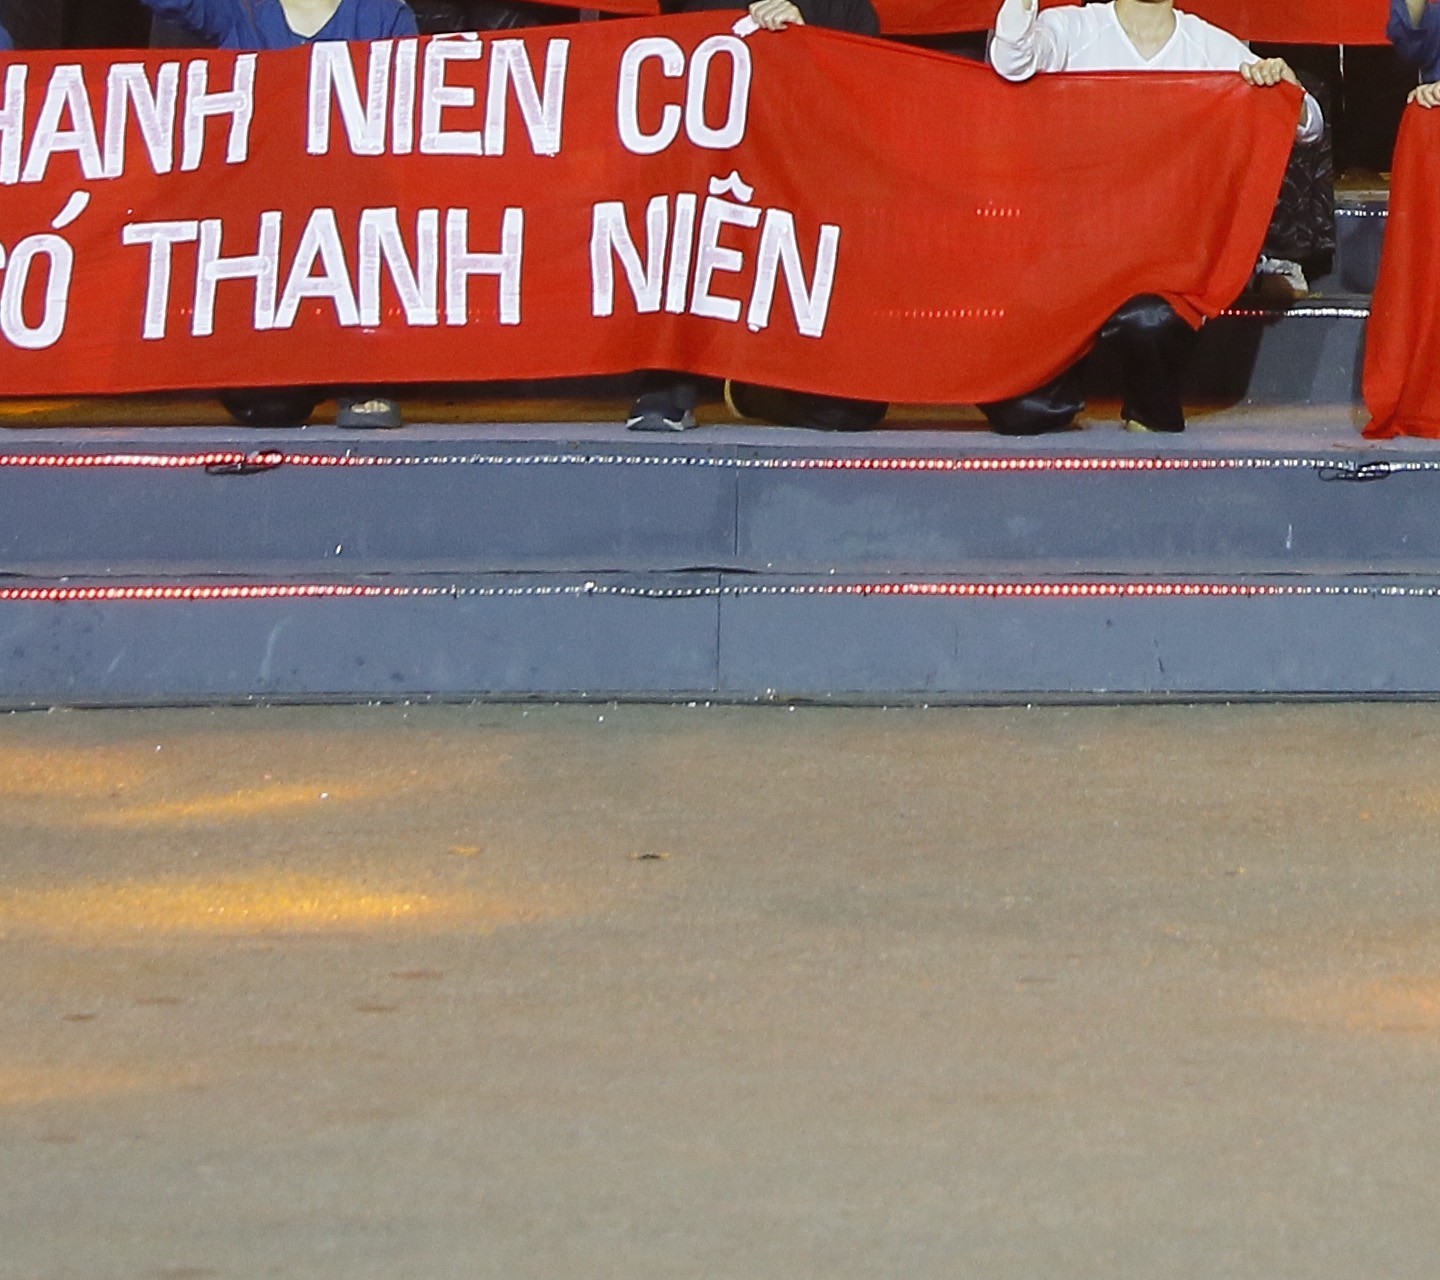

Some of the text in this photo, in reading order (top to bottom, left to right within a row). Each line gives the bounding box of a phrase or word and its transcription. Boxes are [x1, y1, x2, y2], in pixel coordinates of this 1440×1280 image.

[305, 31, 571, 157] NIÊN
[617, 15, 759, 156] CÓ
[121, 206, 523, 341] THANH
[589, 171, 841, 338] NIÊN
